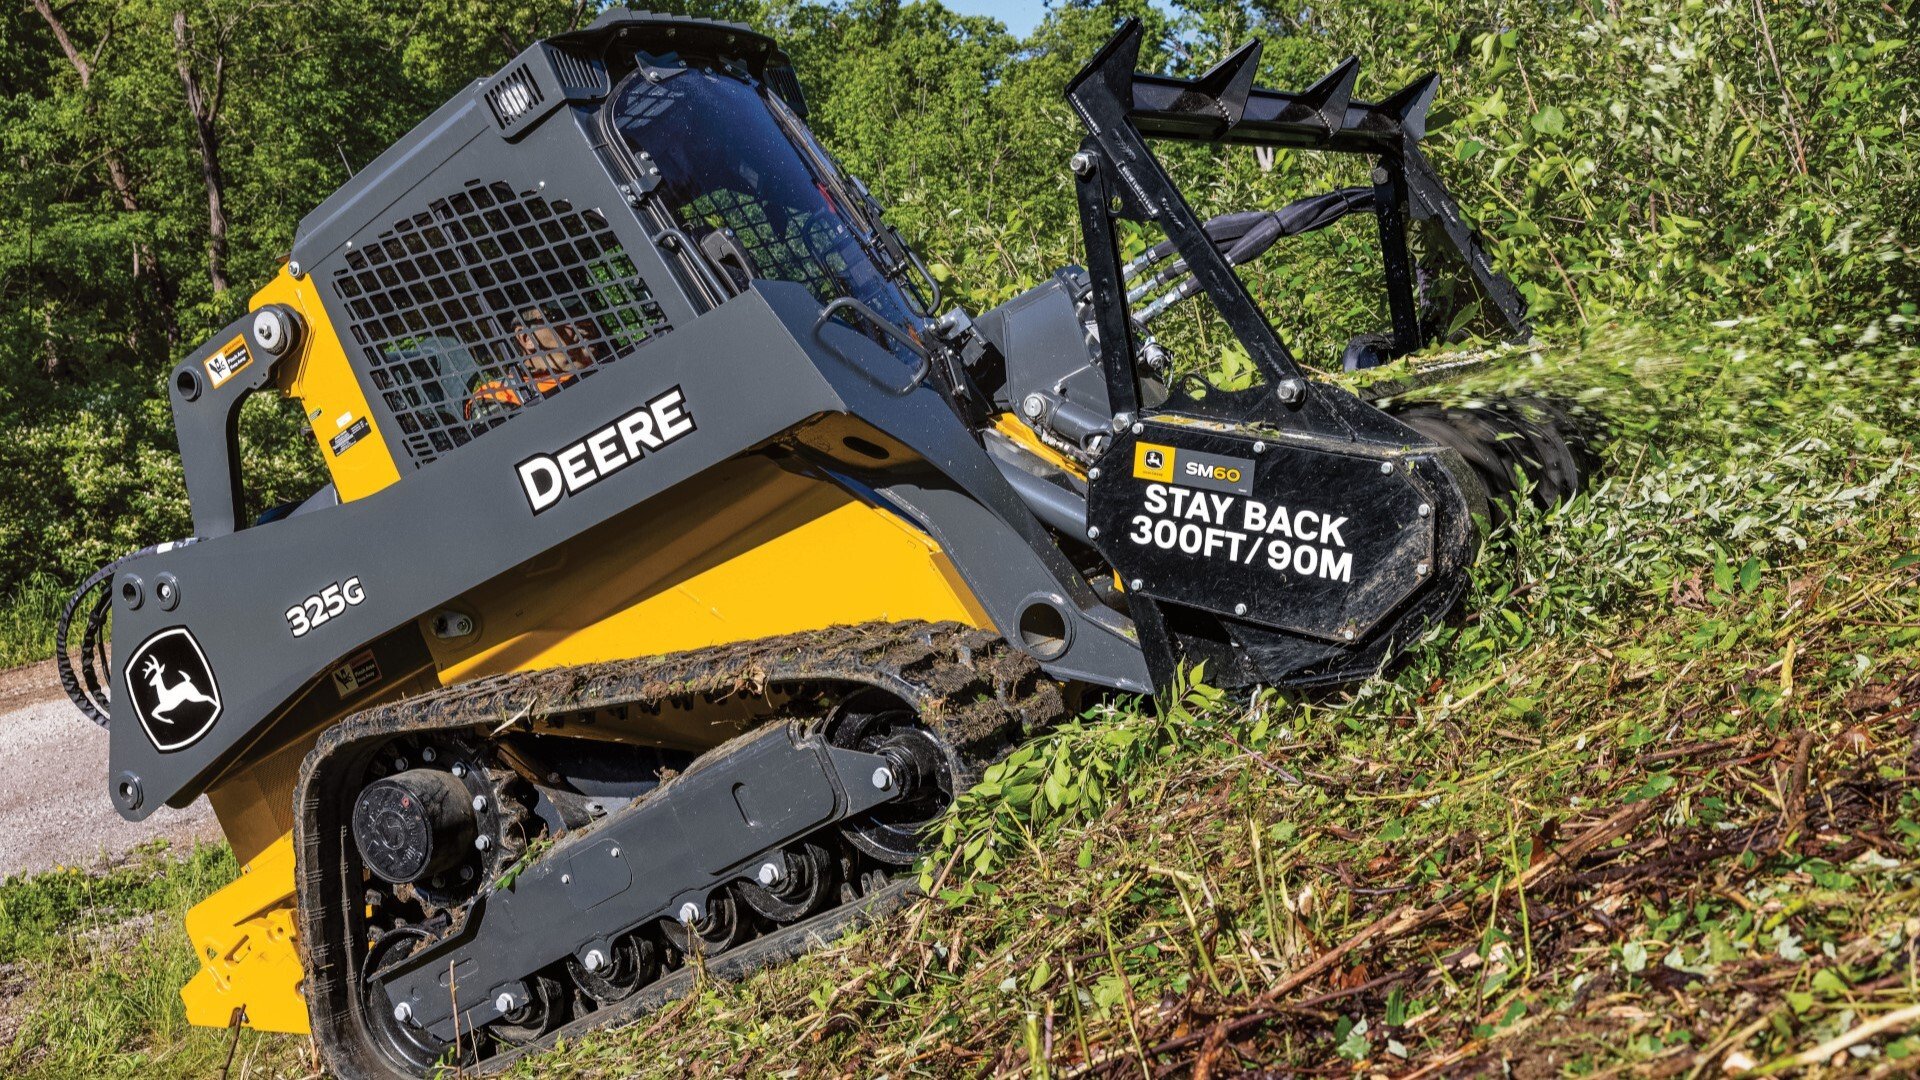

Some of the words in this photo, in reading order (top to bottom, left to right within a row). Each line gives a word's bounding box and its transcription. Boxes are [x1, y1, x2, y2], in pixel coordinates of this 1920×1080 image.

[518, 389, 693, 511] DEERE
[1185, 461, 1241, 483] SM60
[1143, 484, 1234, 525] STAY
[1243, 500, 1349, 547] BACK
[285, 576, 366, 637] 325G
